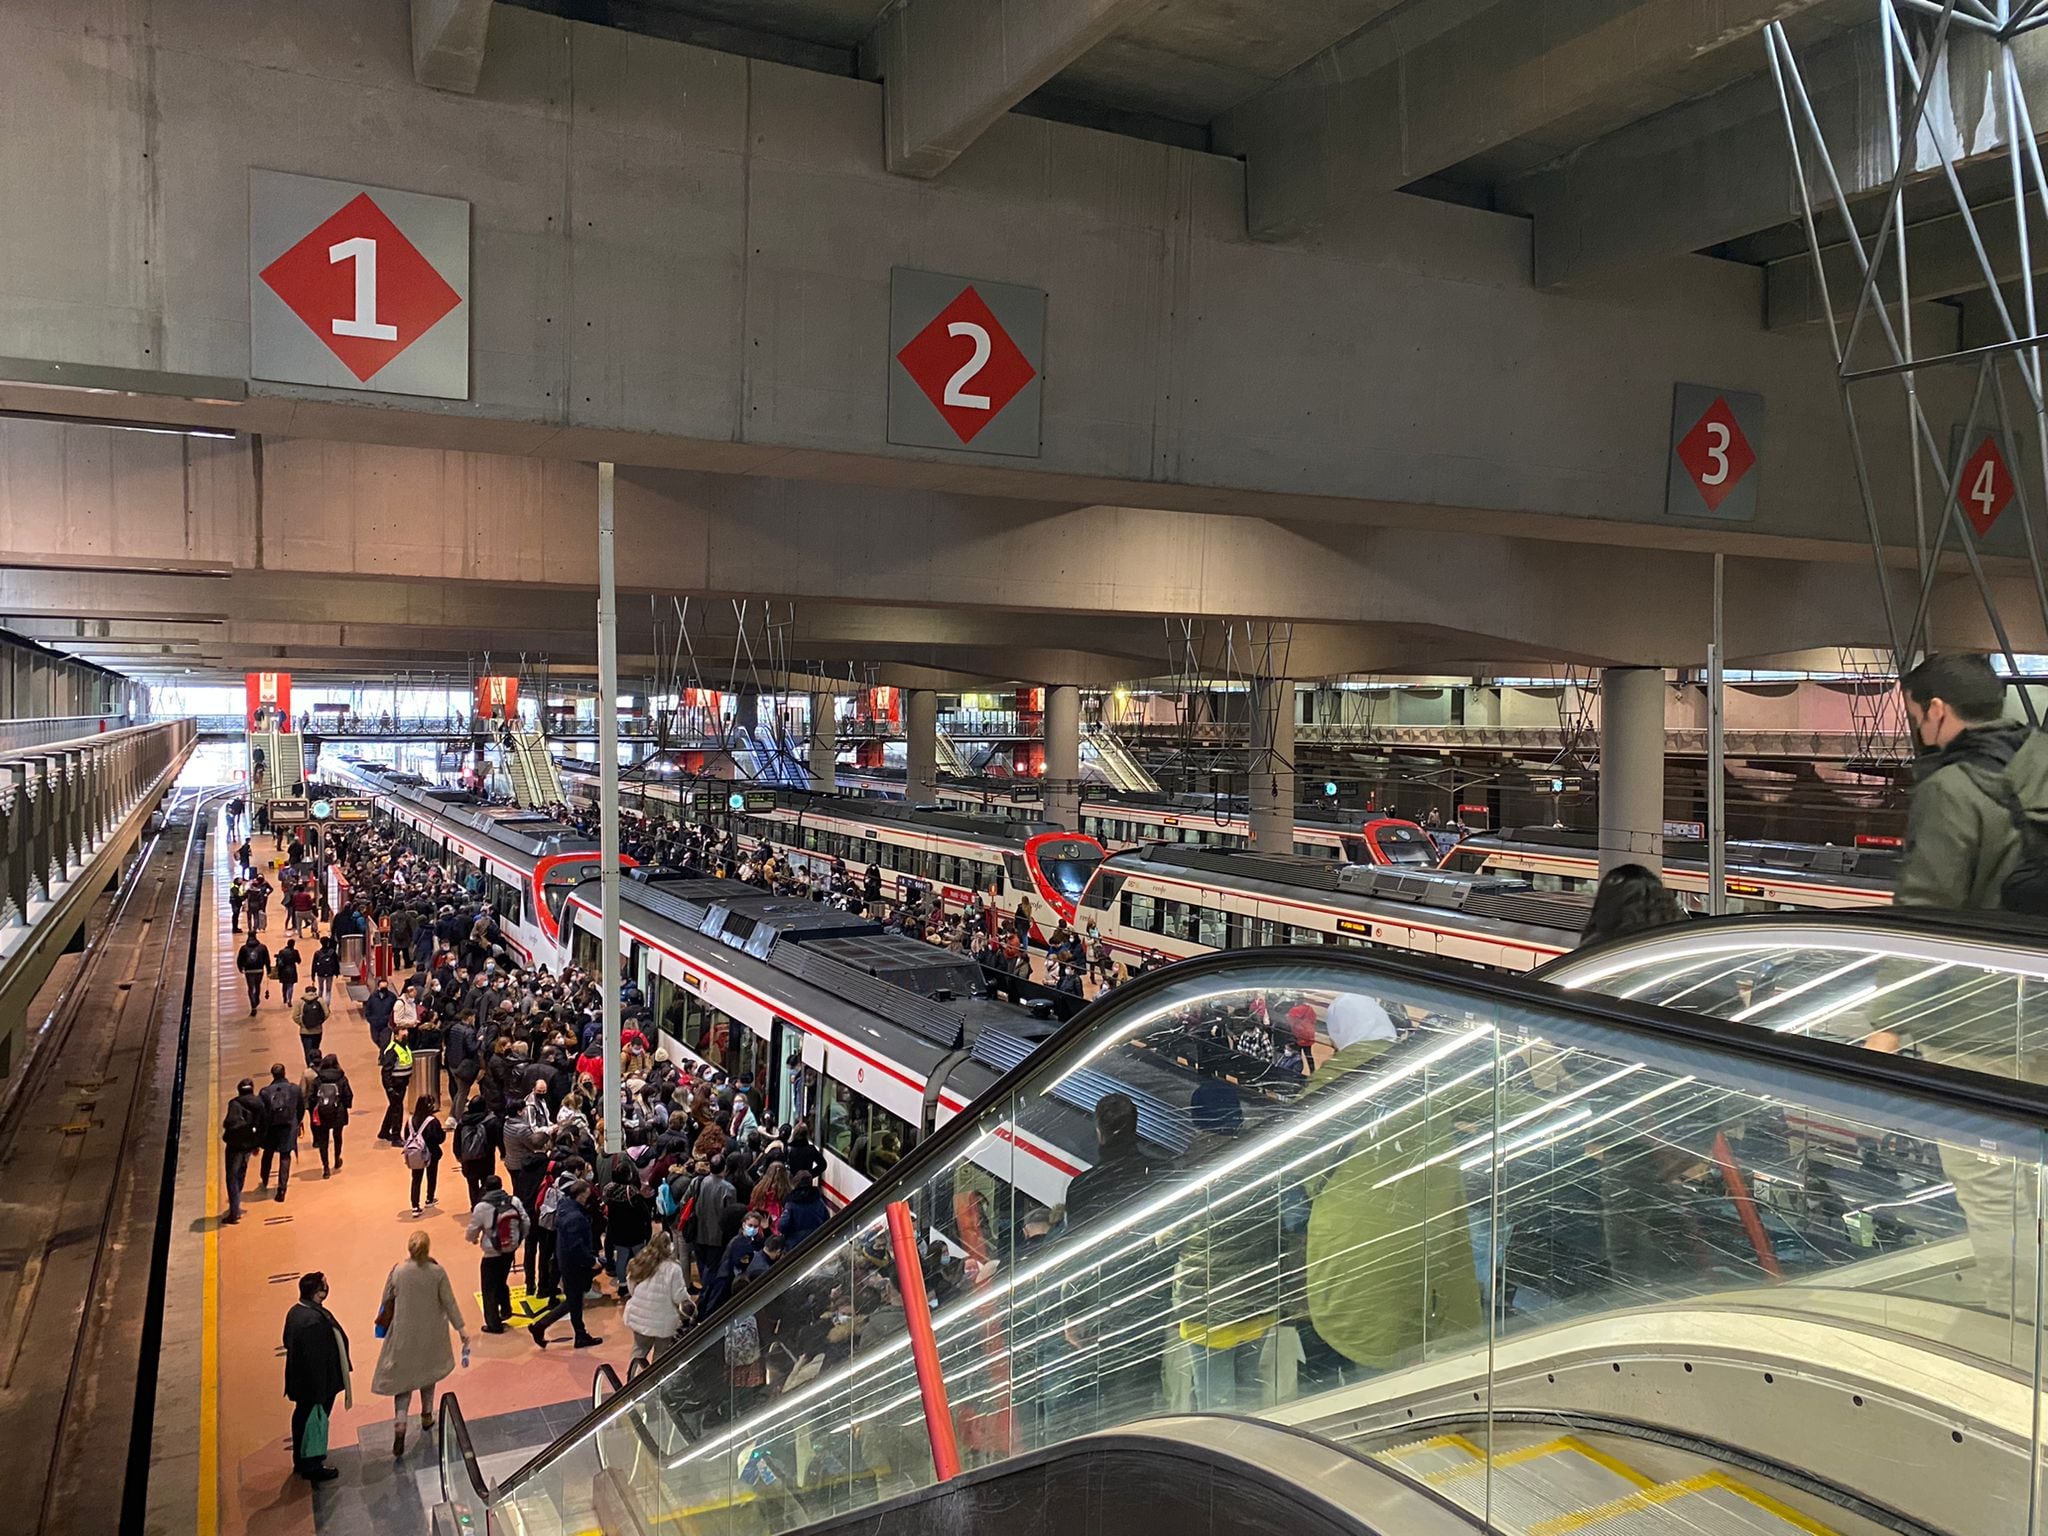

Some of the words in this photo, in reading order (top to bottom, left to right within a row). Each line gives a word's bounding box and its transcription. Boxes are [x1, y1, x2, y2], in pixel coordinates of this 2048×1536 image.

[329, 237, 397, 341] 1
[944, 322, 991, 410] 2
[1702, 422, 1730, 485] 3
[1971, 460, 1995, 515] 4
[1152, 885, 1167, 895] renfe
